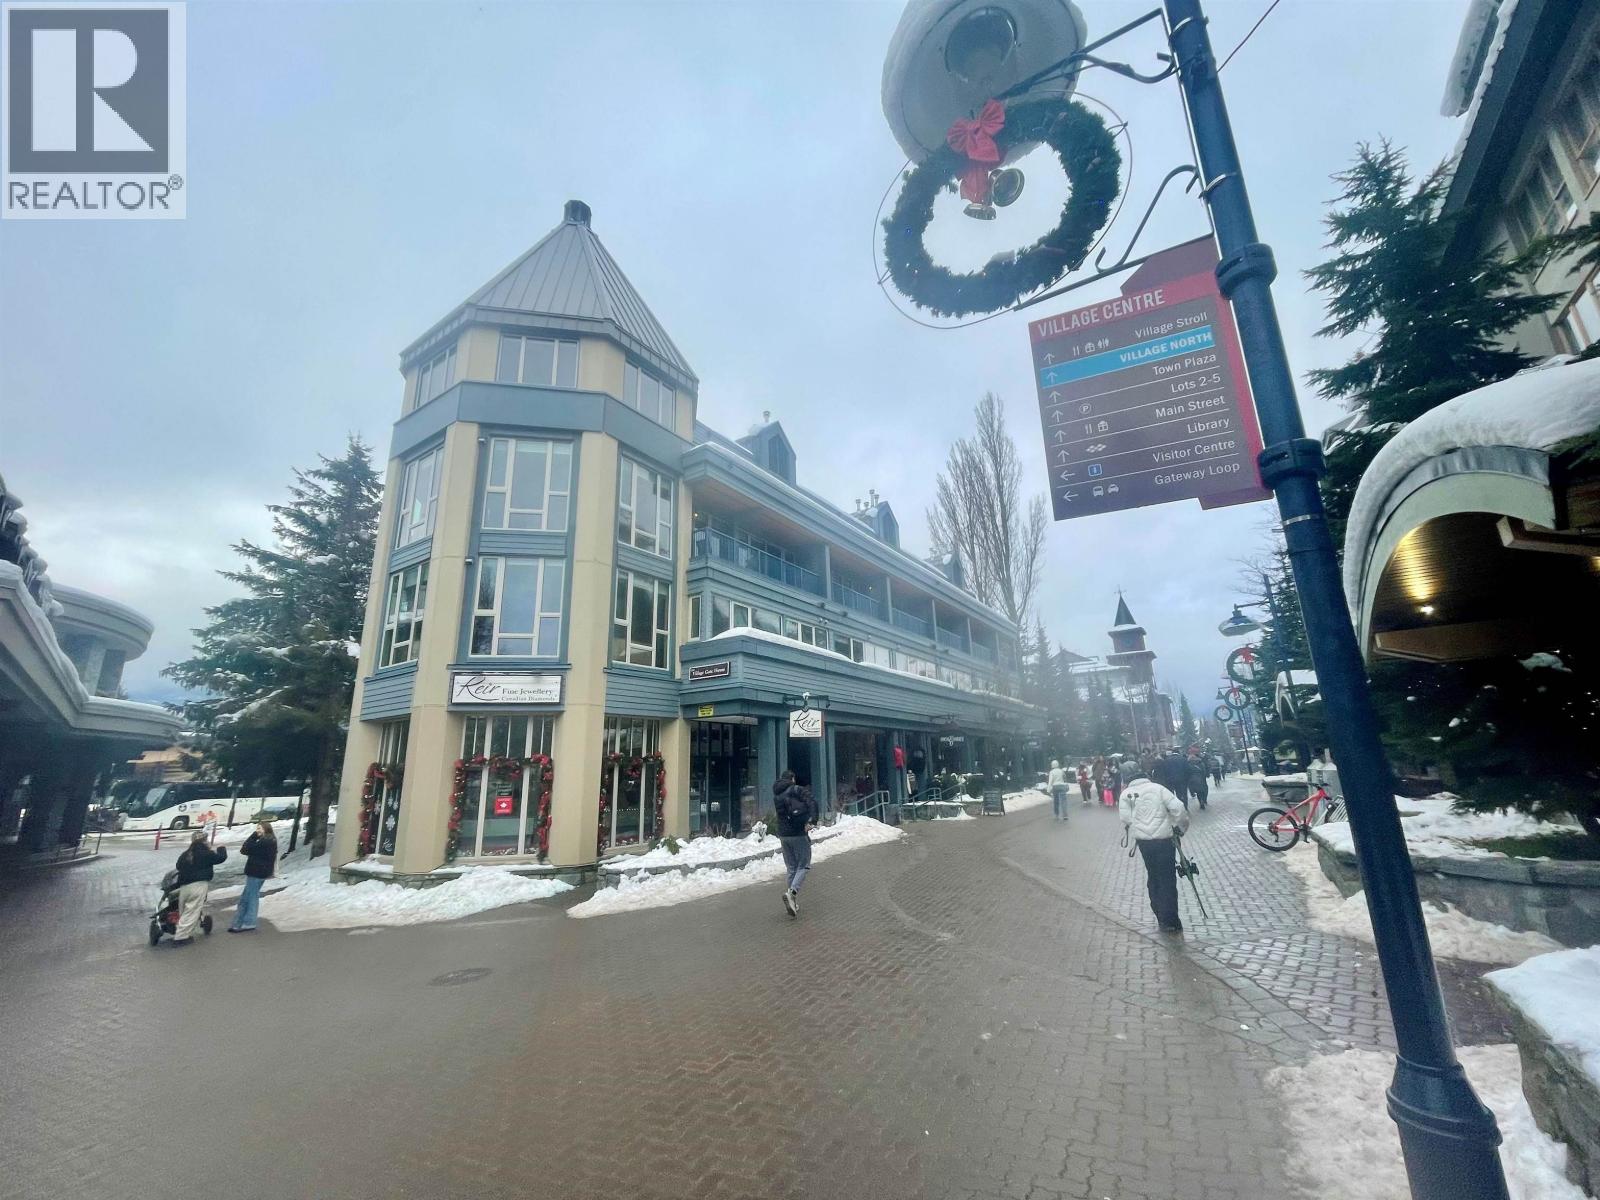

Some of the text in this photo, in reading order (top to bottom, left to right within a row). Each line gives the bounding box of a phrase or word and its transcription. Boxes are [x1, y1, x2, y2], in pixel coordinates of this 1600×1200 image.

[1038, 289, 1166, 337] VILLAGE CENTRE
[1134, 311, 1208, 339] Village Stroll
[1119, 332, 1213, 363] VILLAGE NORTH
[1152, 353, 1217, 376] Town Plaza
[1170, 374, 1221, 393] Lots 2-5
[1155, 395, 1225, 418] Main Street
[1187, 418, 1230, 434] Library
[1152, 439, 1236, 463] Visitor Centre
[1154, 461, 1241, 485] Gateway Loop
